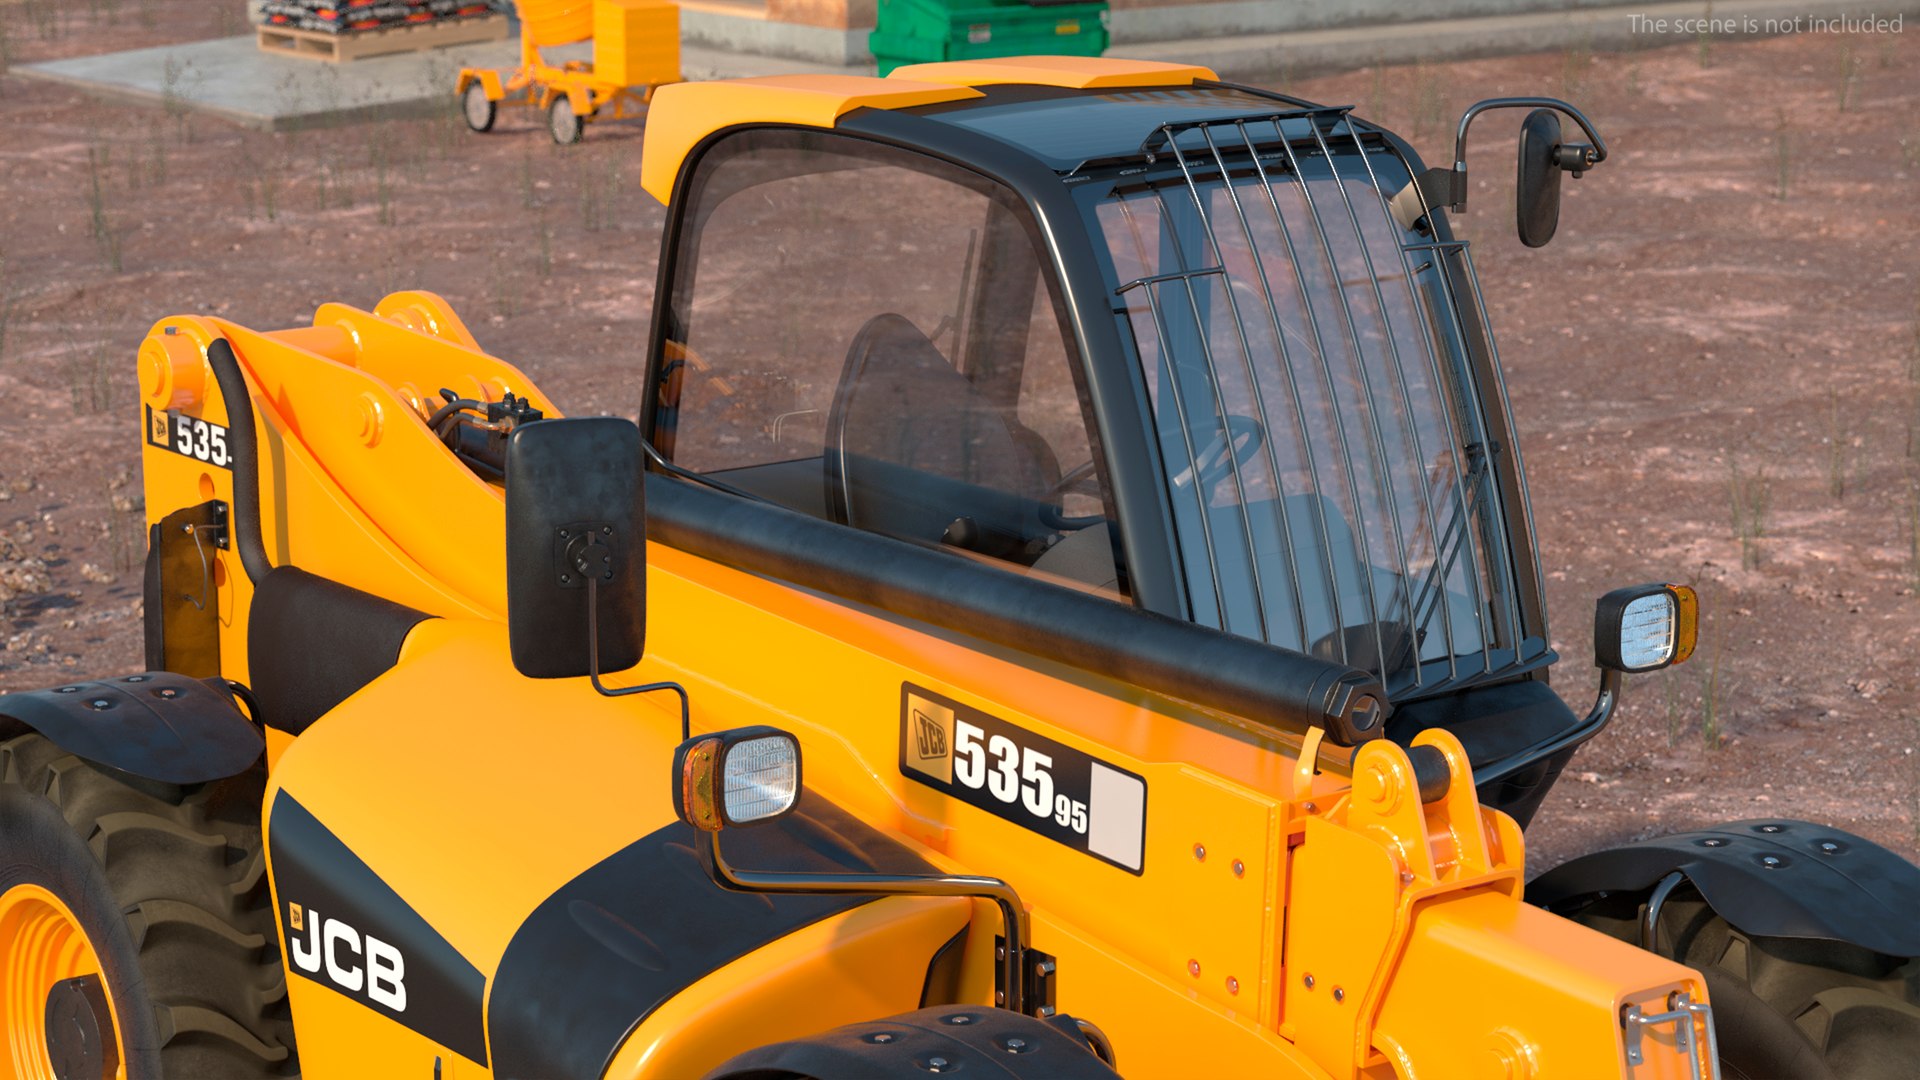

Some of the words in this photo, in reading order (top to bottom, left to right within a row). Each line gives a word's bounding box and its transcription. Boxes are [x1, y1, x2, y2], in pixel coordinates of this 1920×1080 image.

[919, 715, 946, 755] JCB
[954, 719, 1054, 819] 535
[291, 908, 407, 1012] JCB
